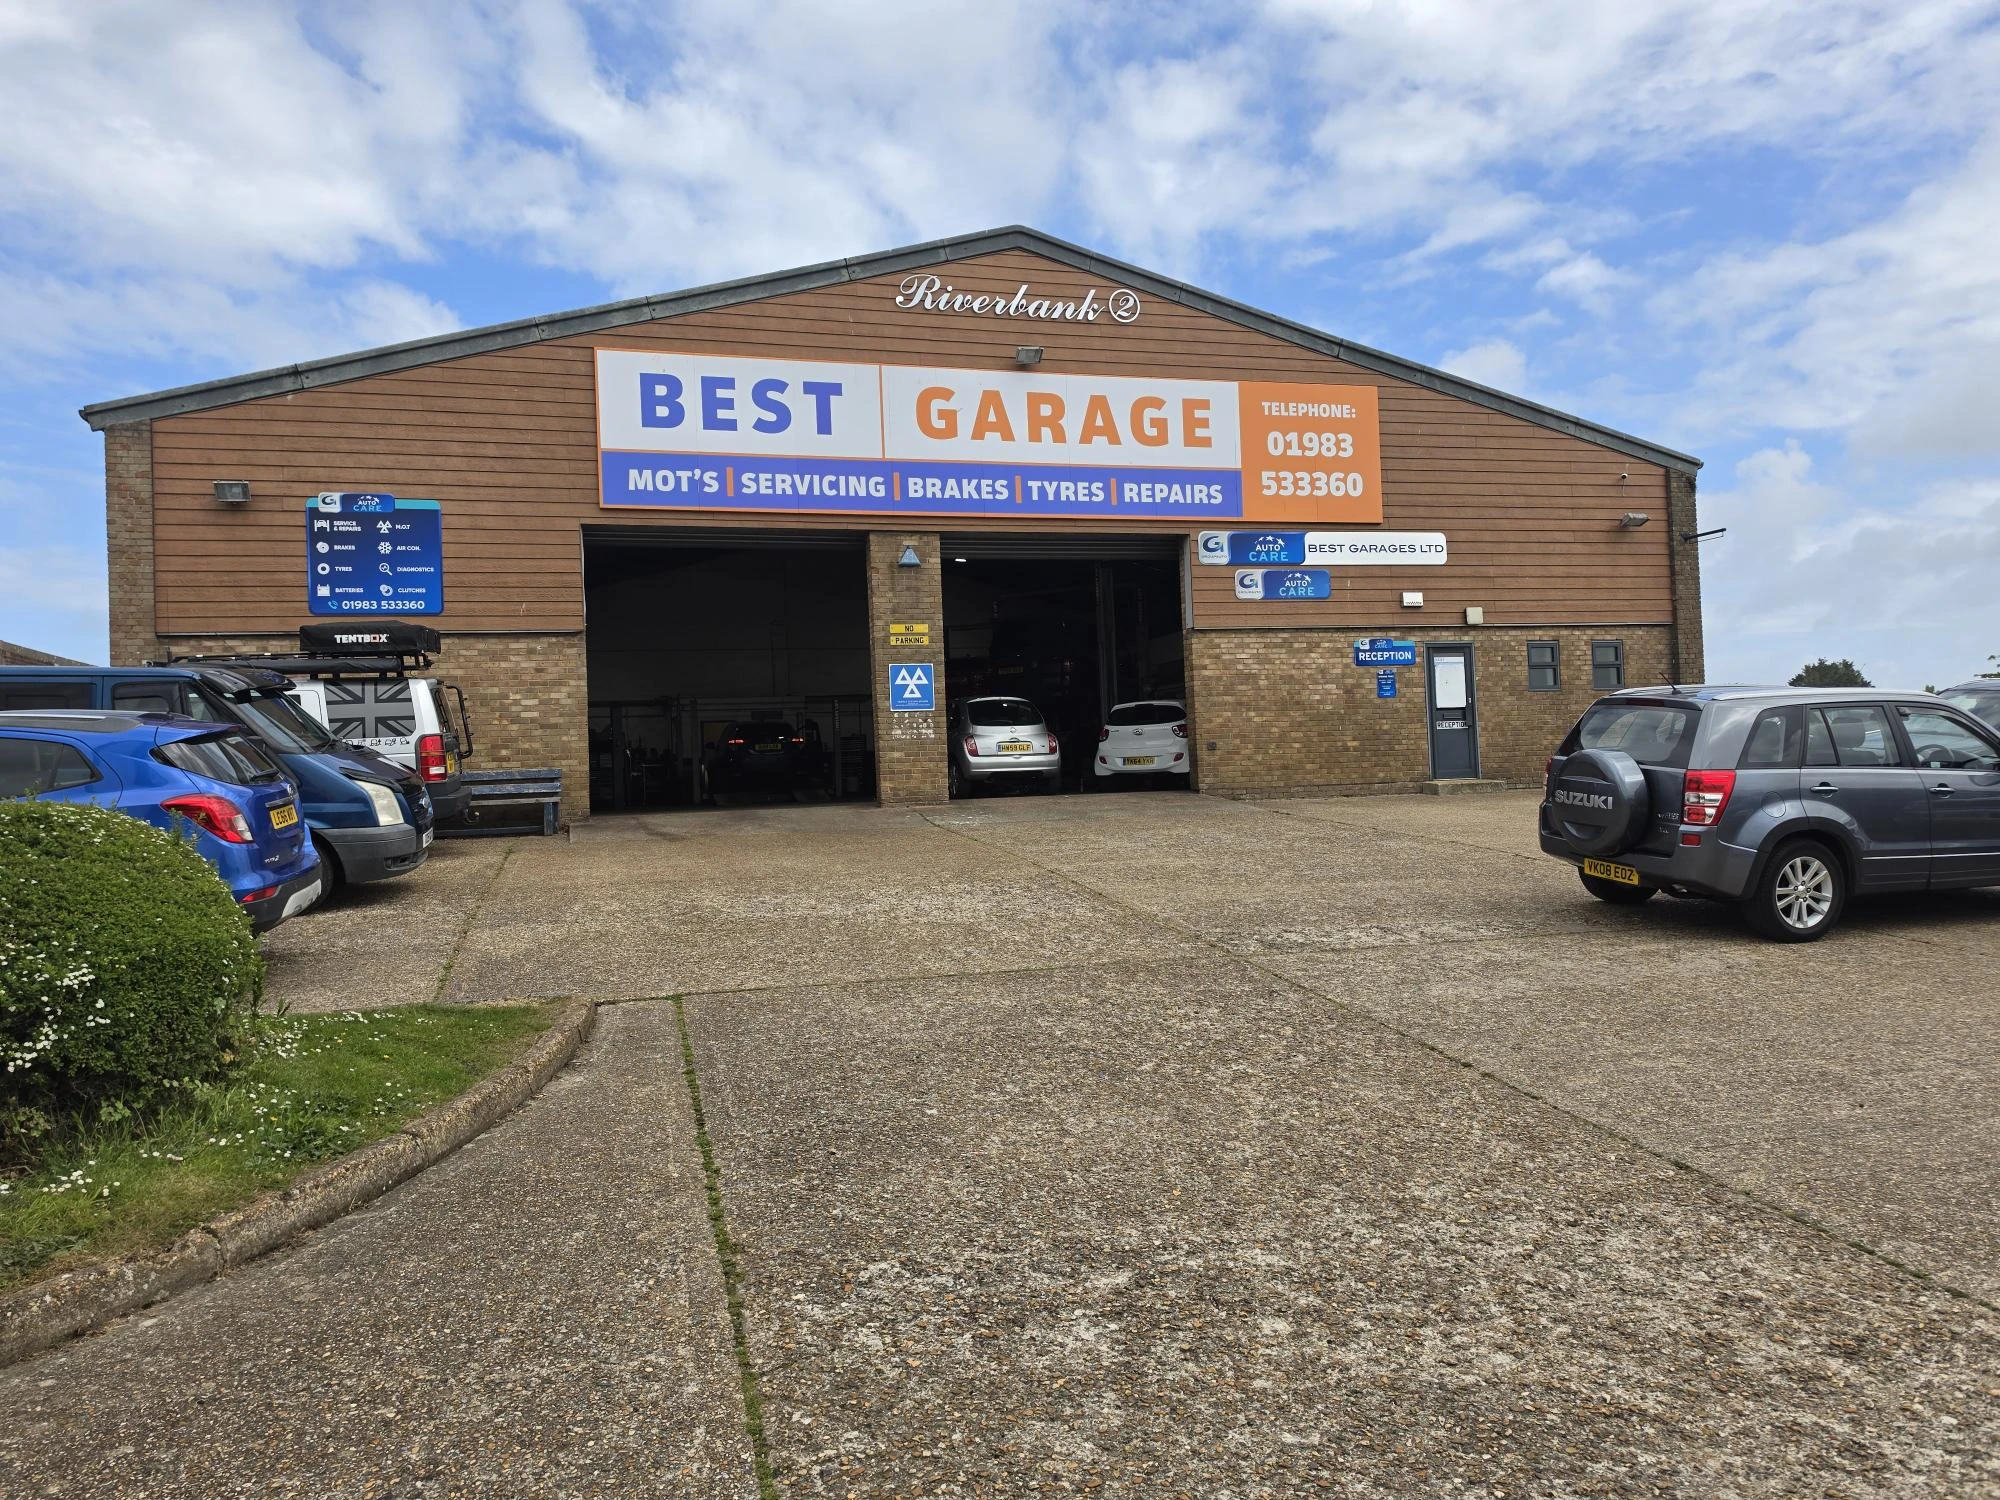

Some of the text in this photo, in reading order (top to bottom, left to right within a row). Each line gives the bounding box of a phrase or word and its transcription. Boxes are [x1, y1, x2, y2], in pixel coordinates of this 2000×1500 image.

[895, 273, 1105, 322] Riverbank
[639, 371, 1213, 448] BEST GARAGE
[1261, 401, 1356, 419] TELEPHONE:
[1266, 431, 1354, 458] 01983
[627, 468, 1223, 505] MOT'S SERVICING BRAKES TYRES REPAIRS
[1261, 470, 1364, 497] 533360
[1248, 551, 1289, 562] CARE
[1308, 544, 1444, 553] BEST GARAGES LTD
[1279, 587, 1315, 596] CARE
[341, 600, 425, 610] 01983 533360
[1358, 651, 1412, 661] RECEPTION
[1554, 789, 1613, 810] SUZUKI
[1587, 860, 1612, 876] VK08
